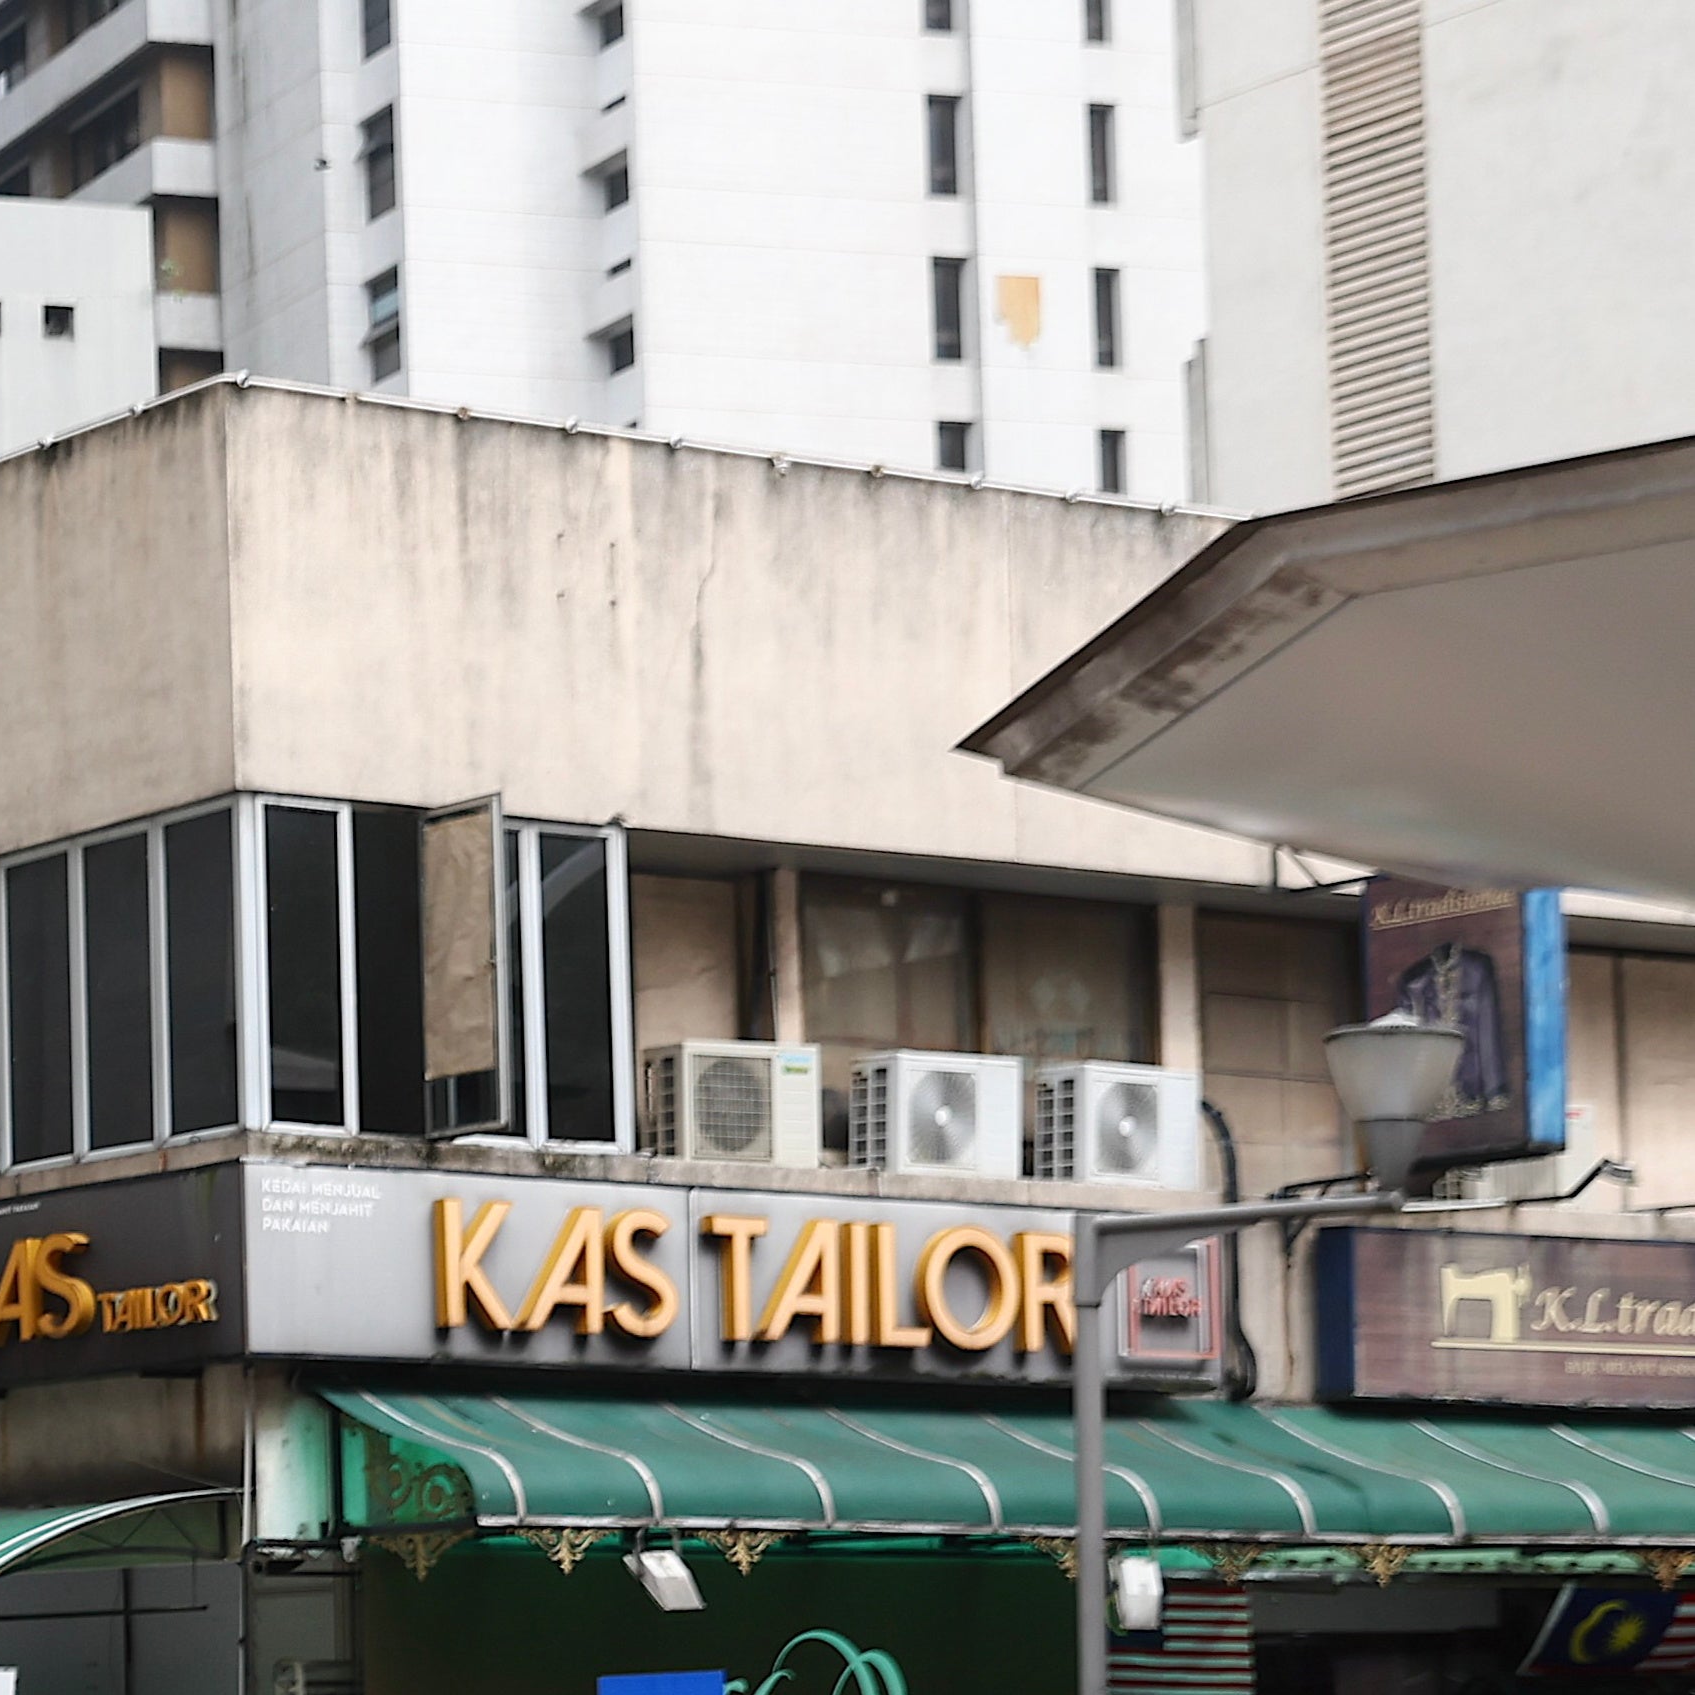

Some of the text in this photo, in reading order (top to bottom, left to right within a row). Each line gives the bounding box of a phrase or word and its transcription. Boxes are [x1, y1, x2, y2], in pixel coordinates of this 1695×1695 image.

[261, 1178, 380, 1200] KEDAI MENJUAL
[261, 1198, 373, 1218] DAN MENJAHIT
[262, 1217, 328, 1233] PAKAIAN
[436, 1198, 1075, 1354] KAS TAILOR
[97, 1279, 219, 1333] TAILOR
